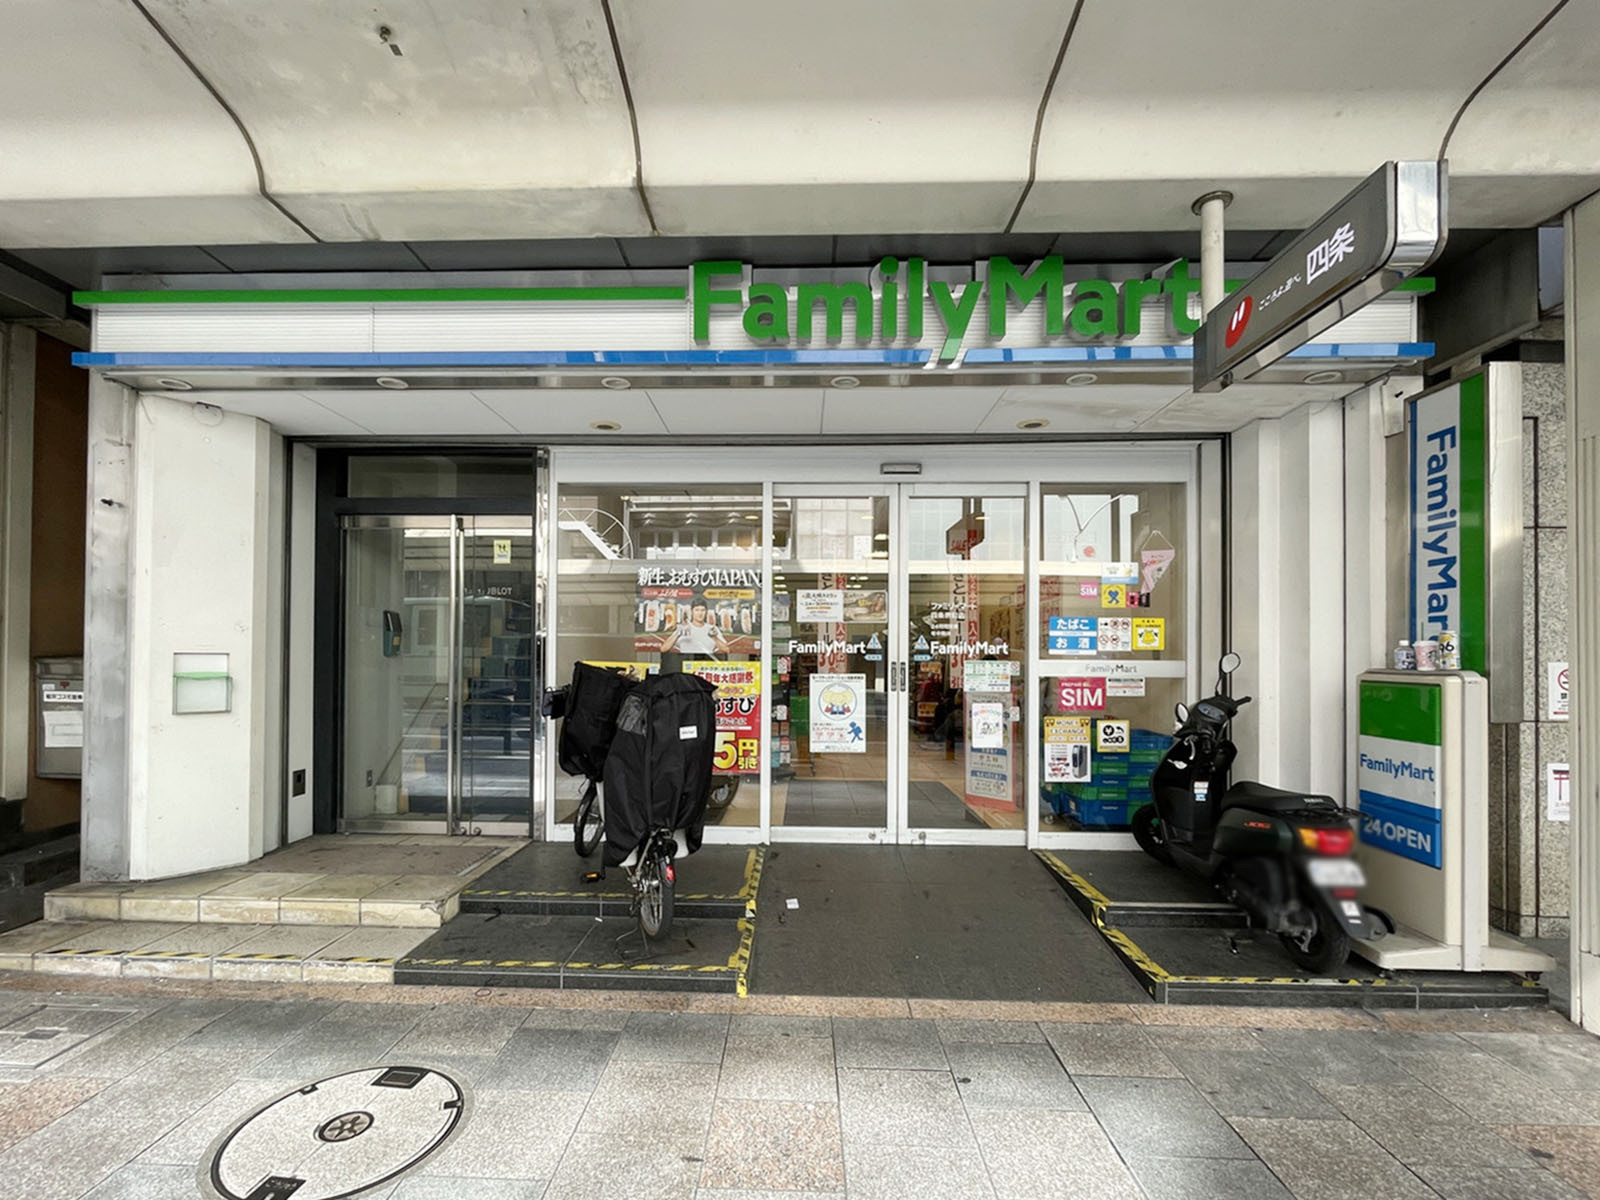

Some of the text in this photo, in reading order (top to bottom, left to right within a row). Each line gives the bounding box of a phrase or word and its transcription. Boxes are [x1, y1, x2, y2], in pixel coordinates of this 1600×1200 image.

[1306, 222, 1355, 285] 四条
[693, 255, 1202, 361] FamilyMart
[1422, 425, 1457, 641] FamilyMar
[1080, 587, 1097, 596] SIM
[1056, 619, 1090, 630] たばこ
[788, 640, 867, 656] FamilyMart
[930, 641, 1009, 656] FamilyMart
[1085, 665, 1137, 674] FamilyMart
[1061, 688, 1103, 706] SIM
[1360, 753, 1435, 782] FamilyMart
